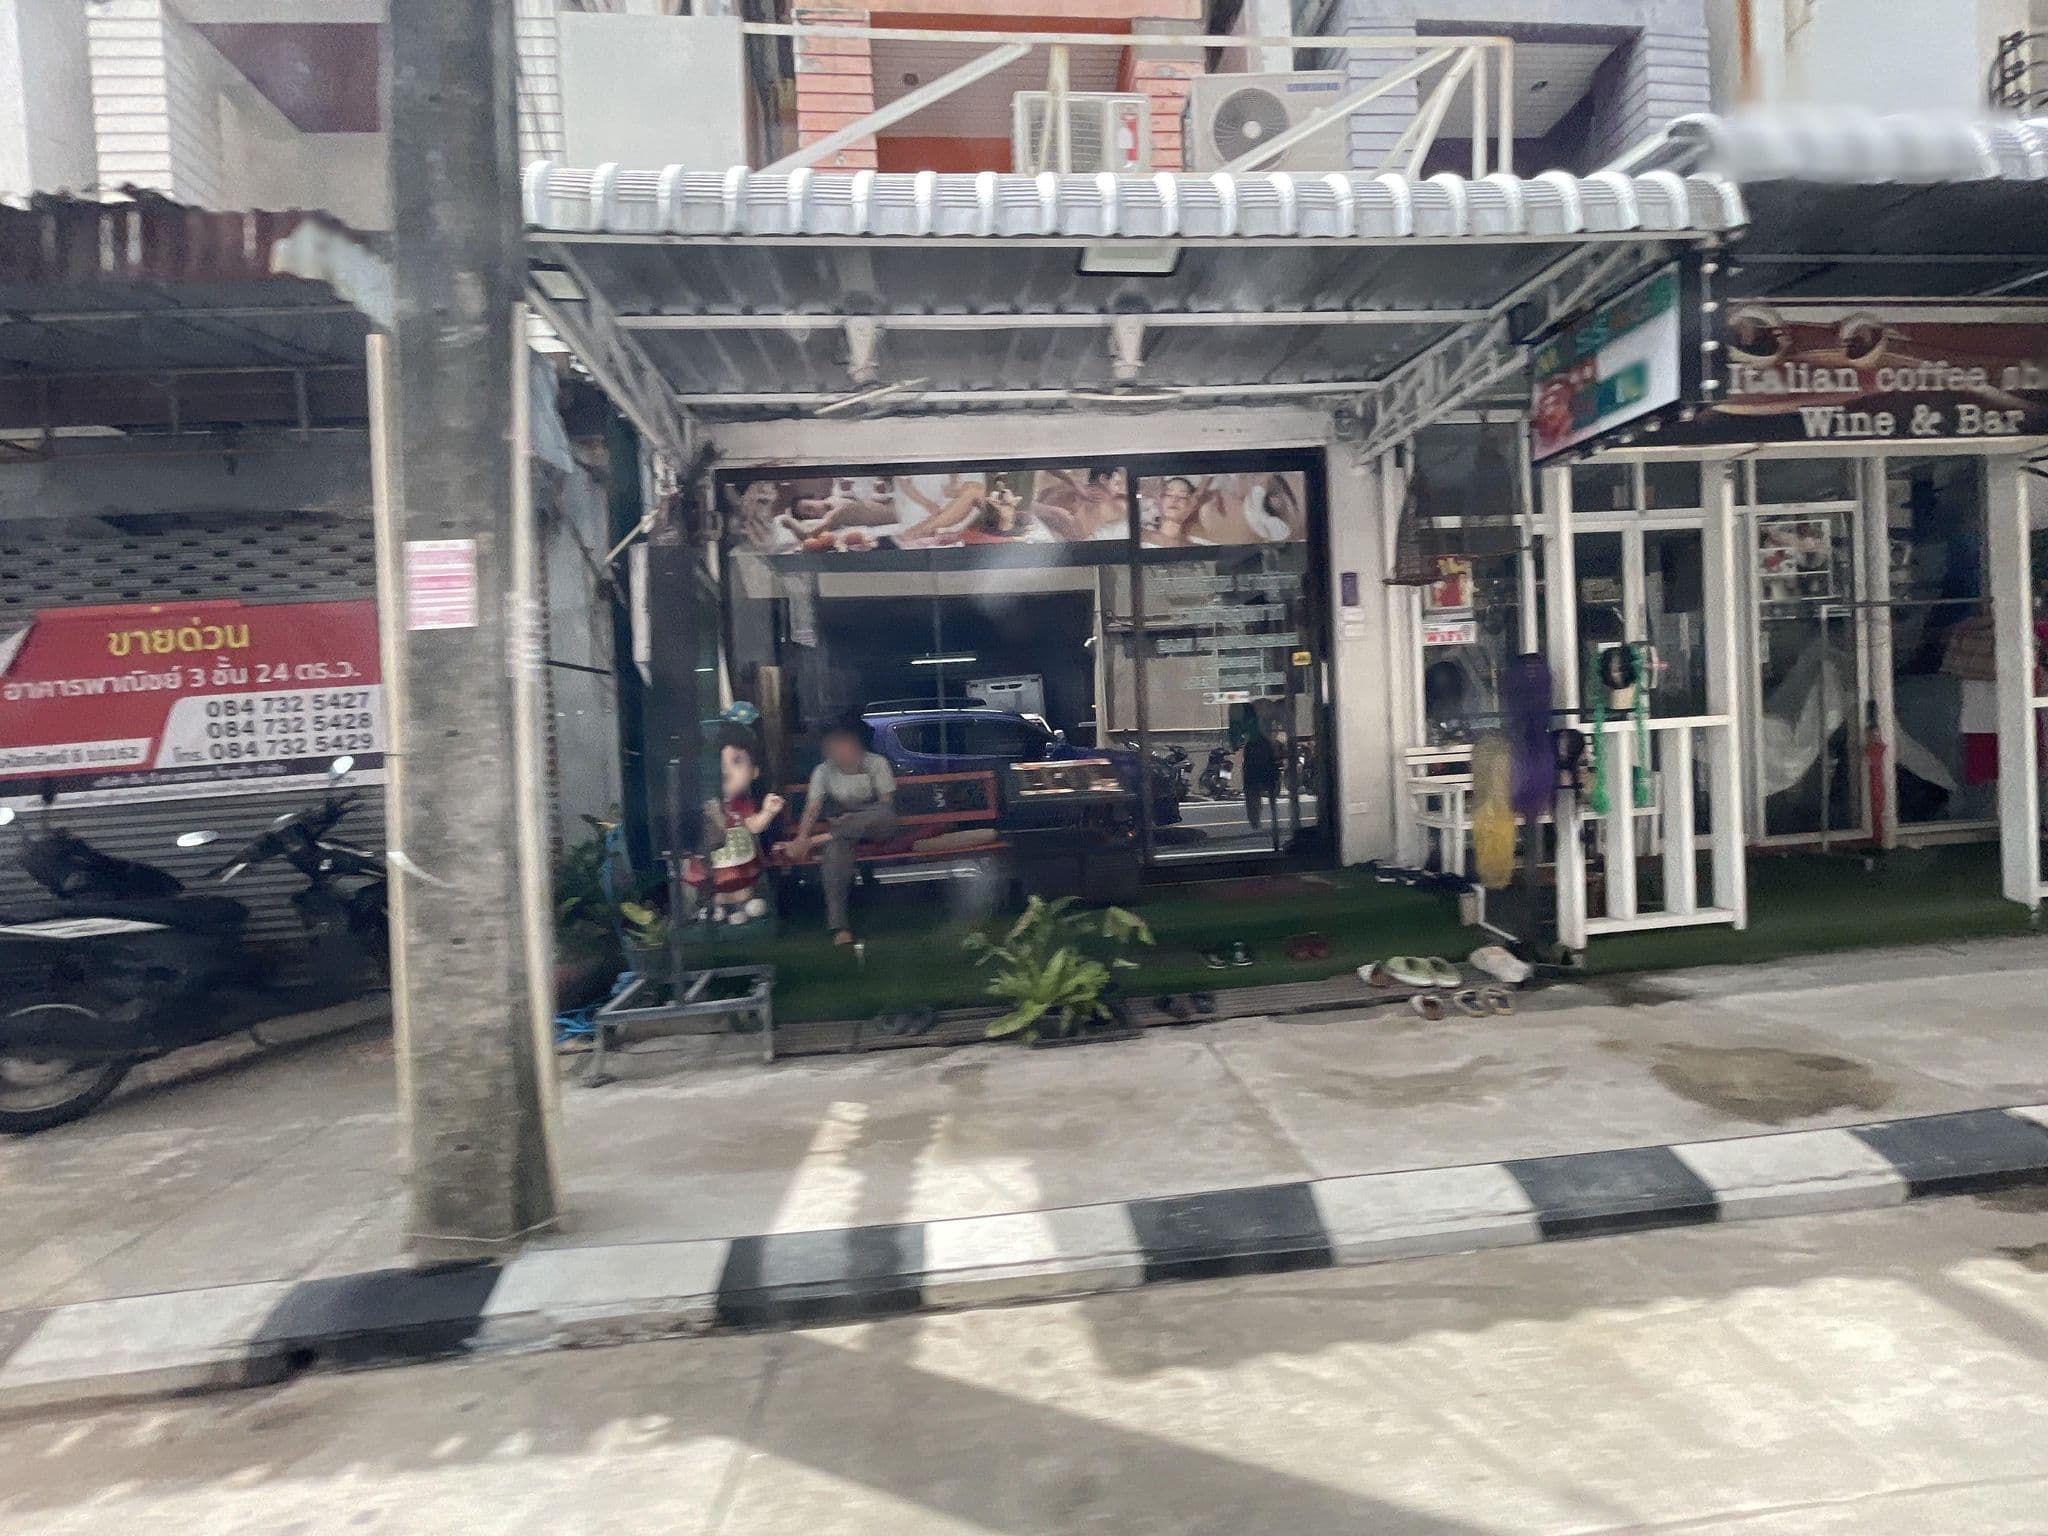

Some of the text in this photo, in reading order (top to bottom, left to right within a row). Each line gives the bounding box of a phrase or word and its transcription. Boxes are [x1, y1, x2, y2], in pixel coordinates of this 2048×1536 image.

[1726, 361, 1860, 394] Italian
[1875, 359, 1989, 392] coffee
[1800, 403, 2026, 437] Wine & Bar
[108, 616, 250, 657] ขายด่วน
[2, 665, 184, 701] อาคารพาณิชย์
[187, 667, 206, 688] 3
[212, 656, 248, 686] ชั้น
[255, 662, 290, 684] 24
[206, 692, 370, 718] 084 732 5427
[207, 713, 373, 739] 084 732 5428
[208, 741, 259, 760] 084
[265, 738, 307, 756] 732
[314, 733, 374, 752] 5429
